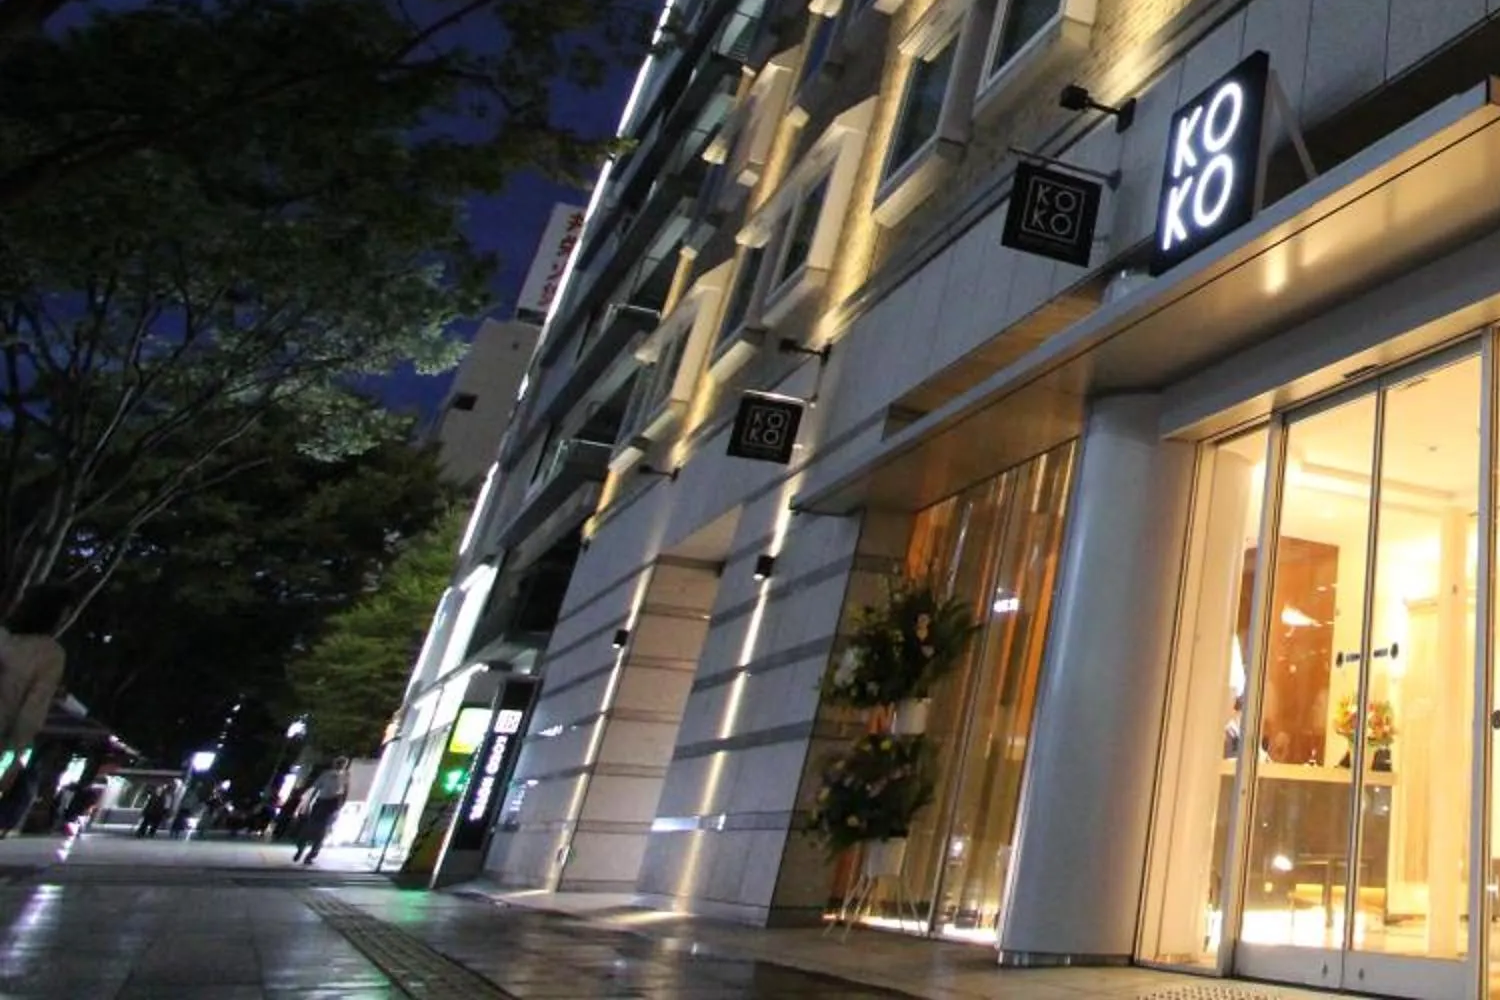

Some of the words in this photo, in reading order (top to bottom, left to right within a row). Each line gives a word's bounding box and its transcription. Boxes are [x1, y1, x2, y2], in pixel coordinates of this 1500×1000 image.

[1173, 81, 1243, 178] KO
[1032, 205, 1072, 235] KO
[1037, 184, 1077, 212] KO
[1163, 154, 1233, 251] KO
